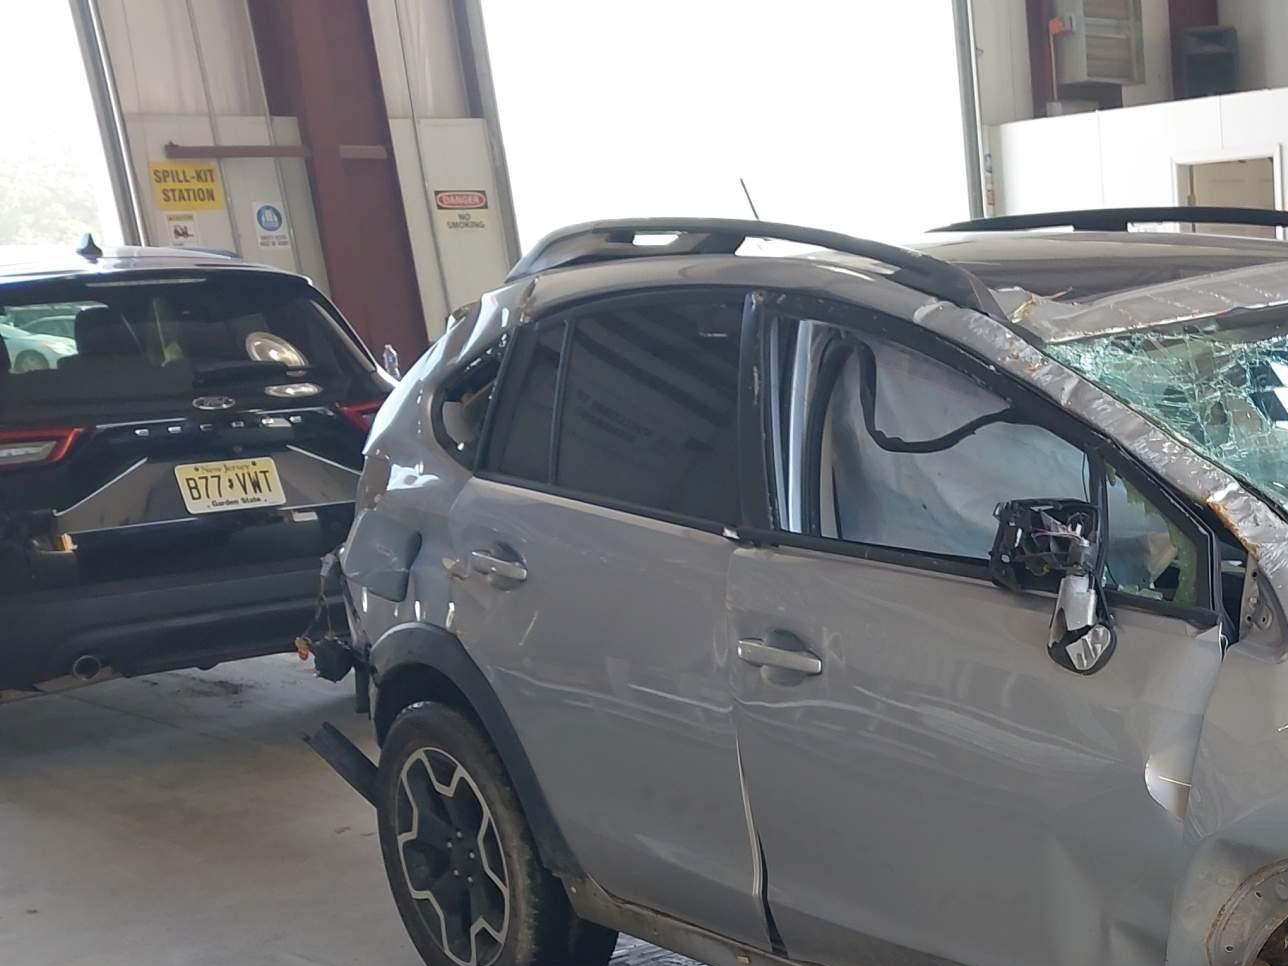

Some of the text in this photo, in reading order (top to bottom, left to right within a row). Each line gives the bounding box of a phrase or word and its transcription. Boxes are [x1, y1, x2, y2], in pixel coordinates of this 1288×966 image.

[153, 168, 215, 184] SPILL-KIT
[162, 188, 215, 202] STATION
[457, 213, 472, 221] NO
[447, 221, 485, 229] SMOKING
